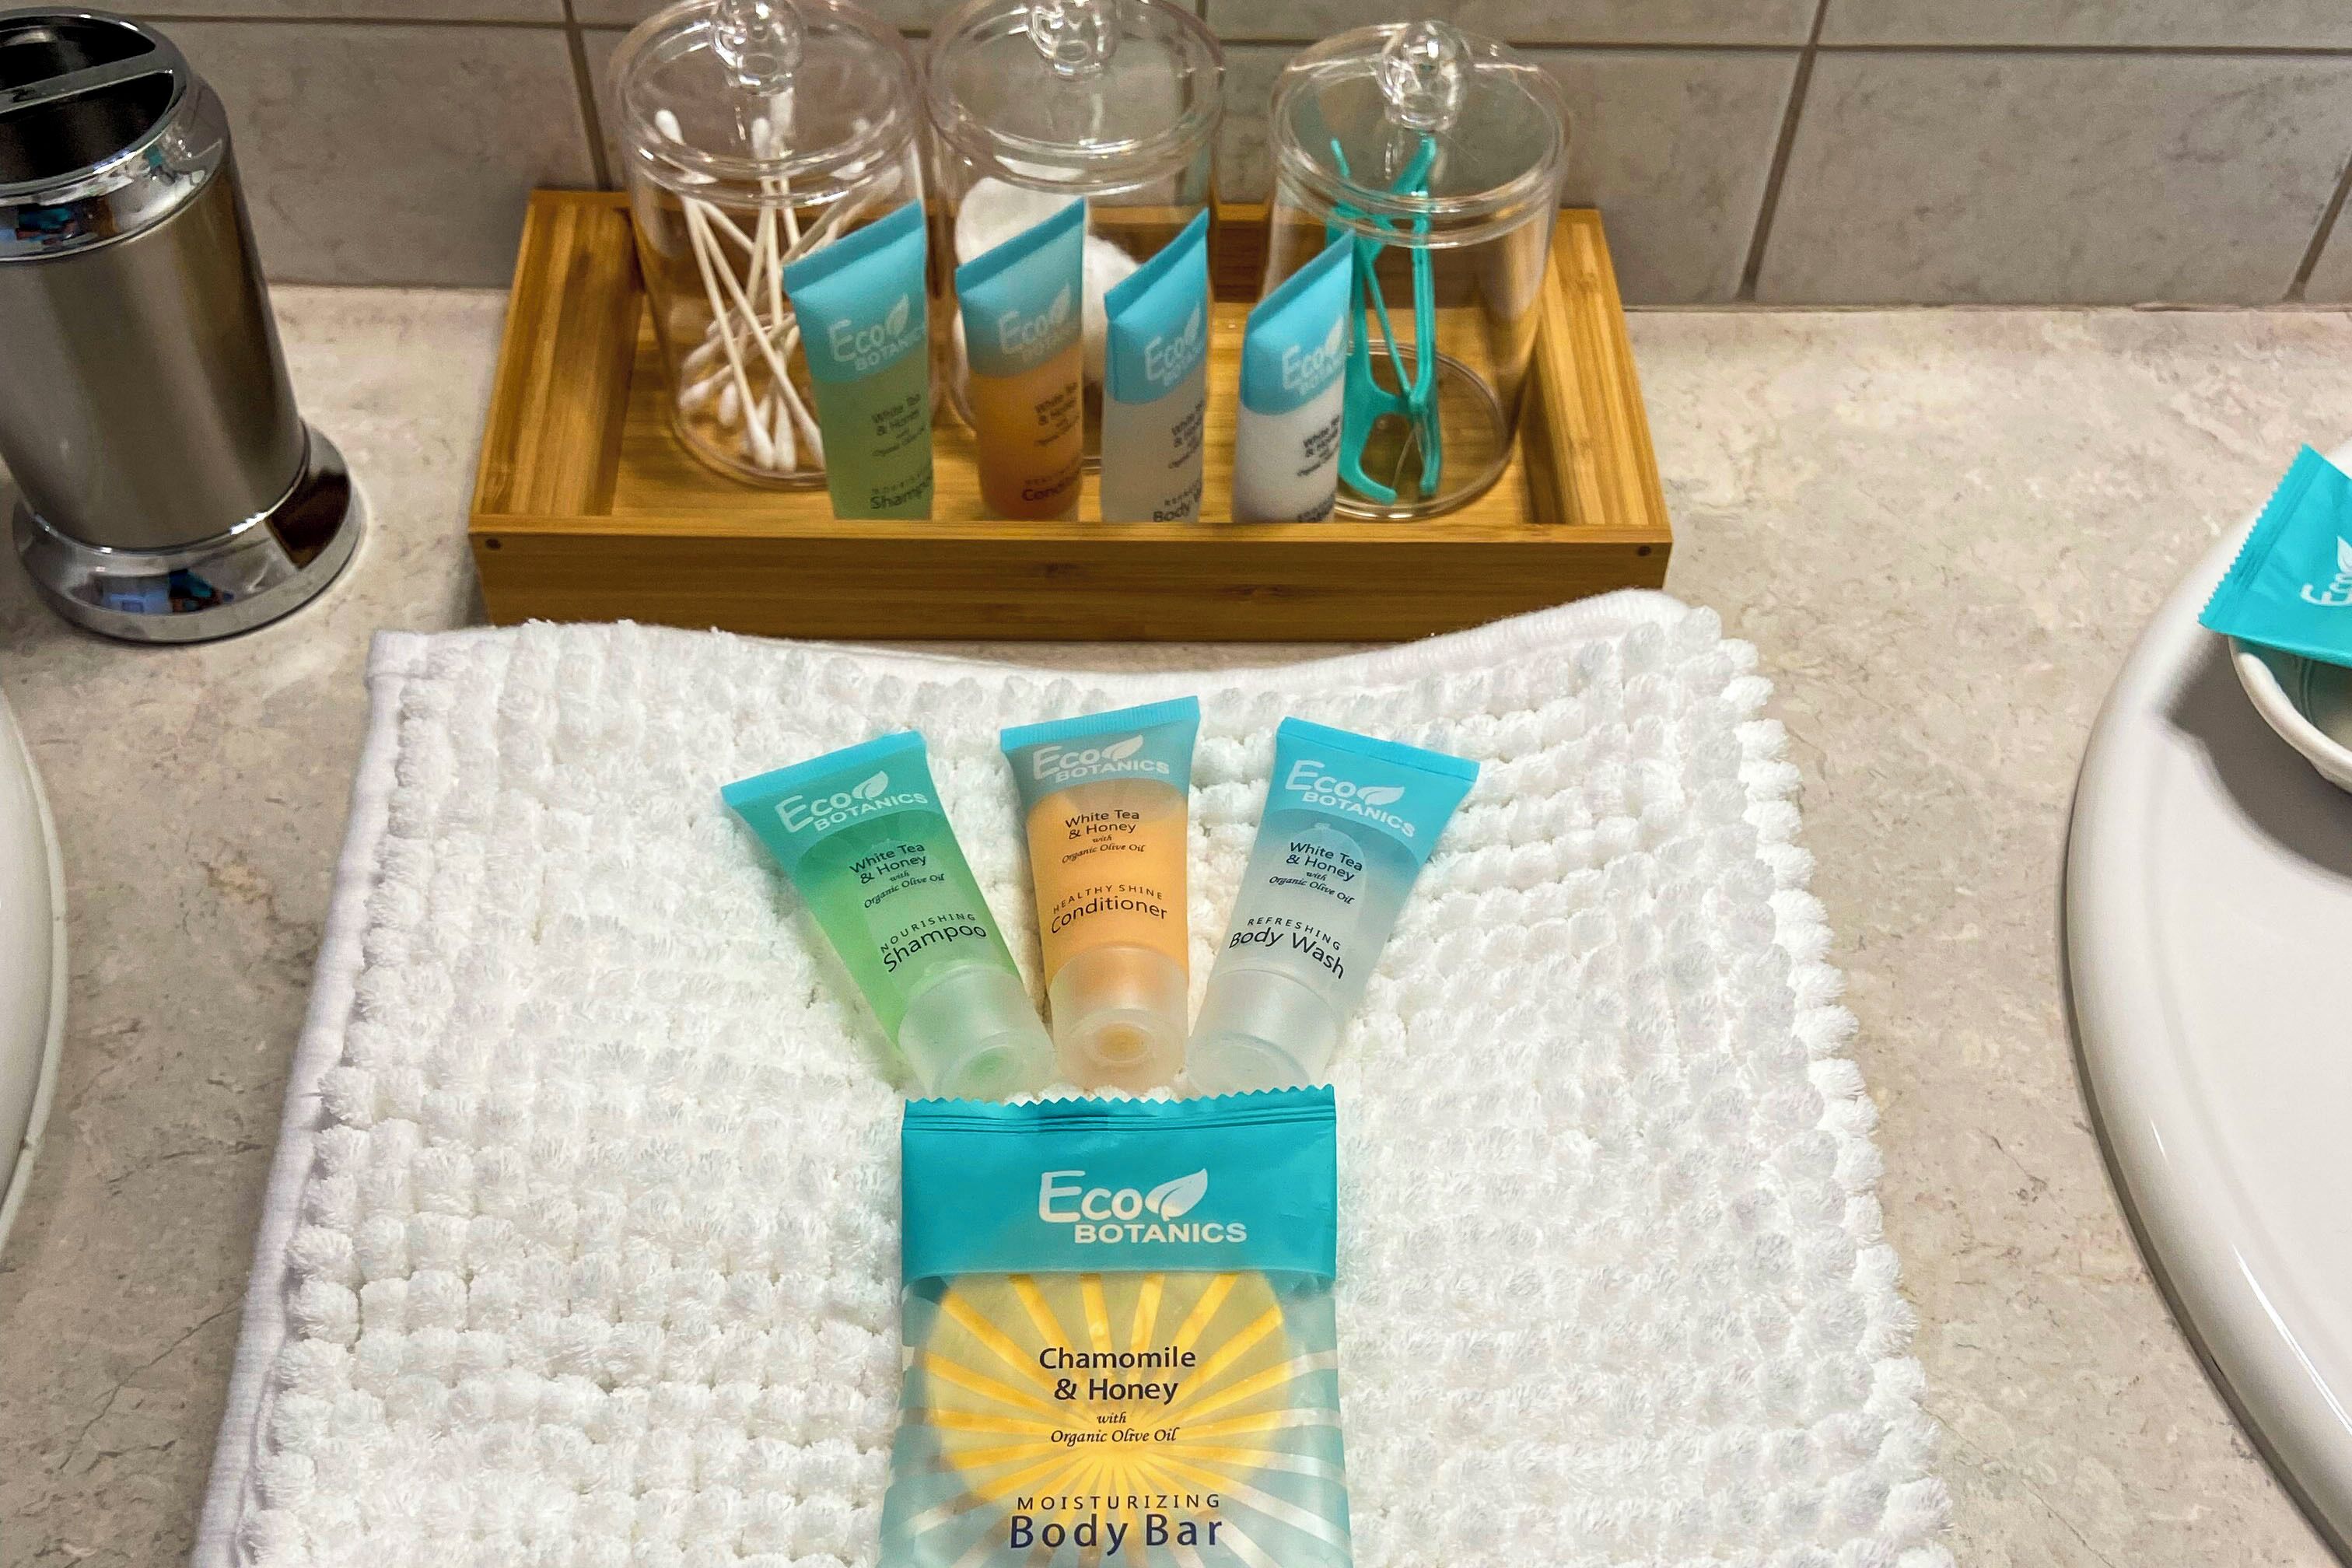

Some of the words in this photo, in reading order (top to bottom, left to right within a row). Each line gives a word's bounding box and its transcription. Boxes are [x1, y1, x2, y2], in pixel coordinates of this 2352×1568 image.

[828, 318, 885, 362] Eco
[856, 324, 926, 371] BOTAN
[999, 310, 1048, 355] Eco
[1144, 336, 1184, 381] Eco
[1281, 345, 1325, 390] Eco
[870, 475, 933, 509] Shampo
[1033, 744, 1101, 780] Eco
[1055, 759, 1170, 784] BOTANICS
[1285, 759, 1356, 797] Eco
[775, 792, 852, 833] Eco
[814, 793, 929, 831] BOTANICS
[1066, 811, 1109, 828] White
[1114, 809, 1139, 820] Tea
[1302, 791, 1415, 838] BOTANICS
[1069, 829, 1081, 840] &
[1087, 822, 1136, 835] Honey
[1092, 835, 1112, 843] with
[849, 849, 895, 874] White
[898, 843, 925, 855] Tea
[1062, 847, 1097, 863] Organic
[1100, 842, 1126, 852] Olive
[1129, 843, 1146, 852] Oil
[1286, 854, 1300, 864] &
[1304, 856, 1355, 882] Honey
[1290, 842, 1334, 859] White
[1340, 852, 1363, 871] Tea
[860, 870, 875, 884] &
[877, 856, 927, 877] Honey
[889, 870, 910, 882] with
[1306, 871, 1327, 881] with
[864, 885, 899, 908] Organic
[901, 877, 927, 888] Olive
[929, 873, 945, 882] Oil
[1054, 884, 1113, 914] HEALTHY
[1119, 884, 1163, 900] SHINE
[1269, 875, 1307, 886] Organic
[1310, 880, 1335, 895] Olive
[1337, 891, 1355, 905] Oil
[1052, 895, 1167, 933] Conditioner
[880, 913, 976, 954] NOURISHING
[884, 925, 987, 972] Shampoo
[1247, 916, 1340, 950] REFRESHING
[1229, 927, 1284, 949] Body
[1292, 933, 1345, 979] Wash
[1038, 1170, 1143, 1223] Eco
[1074, 1223, 1248, 1244] BOTANICS
[1039, 1346, 1196, 1369] Chamomile
[1054, 1378, 1077, 1401] &
[1089, 1378, 1179, 1405] Honey
[1097, 1411, 1126, 1424] with
[1051, 1430, 1108, 1447] Organic
[1111, 1428, 1150, 1442] Olive
[1154, 1427, 1181, 1442] Oil
[1017, 1493, 1220, 1510] MOISTURIZING
[1010, 1514, 1129, 1556] Body
[1146, 1514, 1223, 1546] Bar
